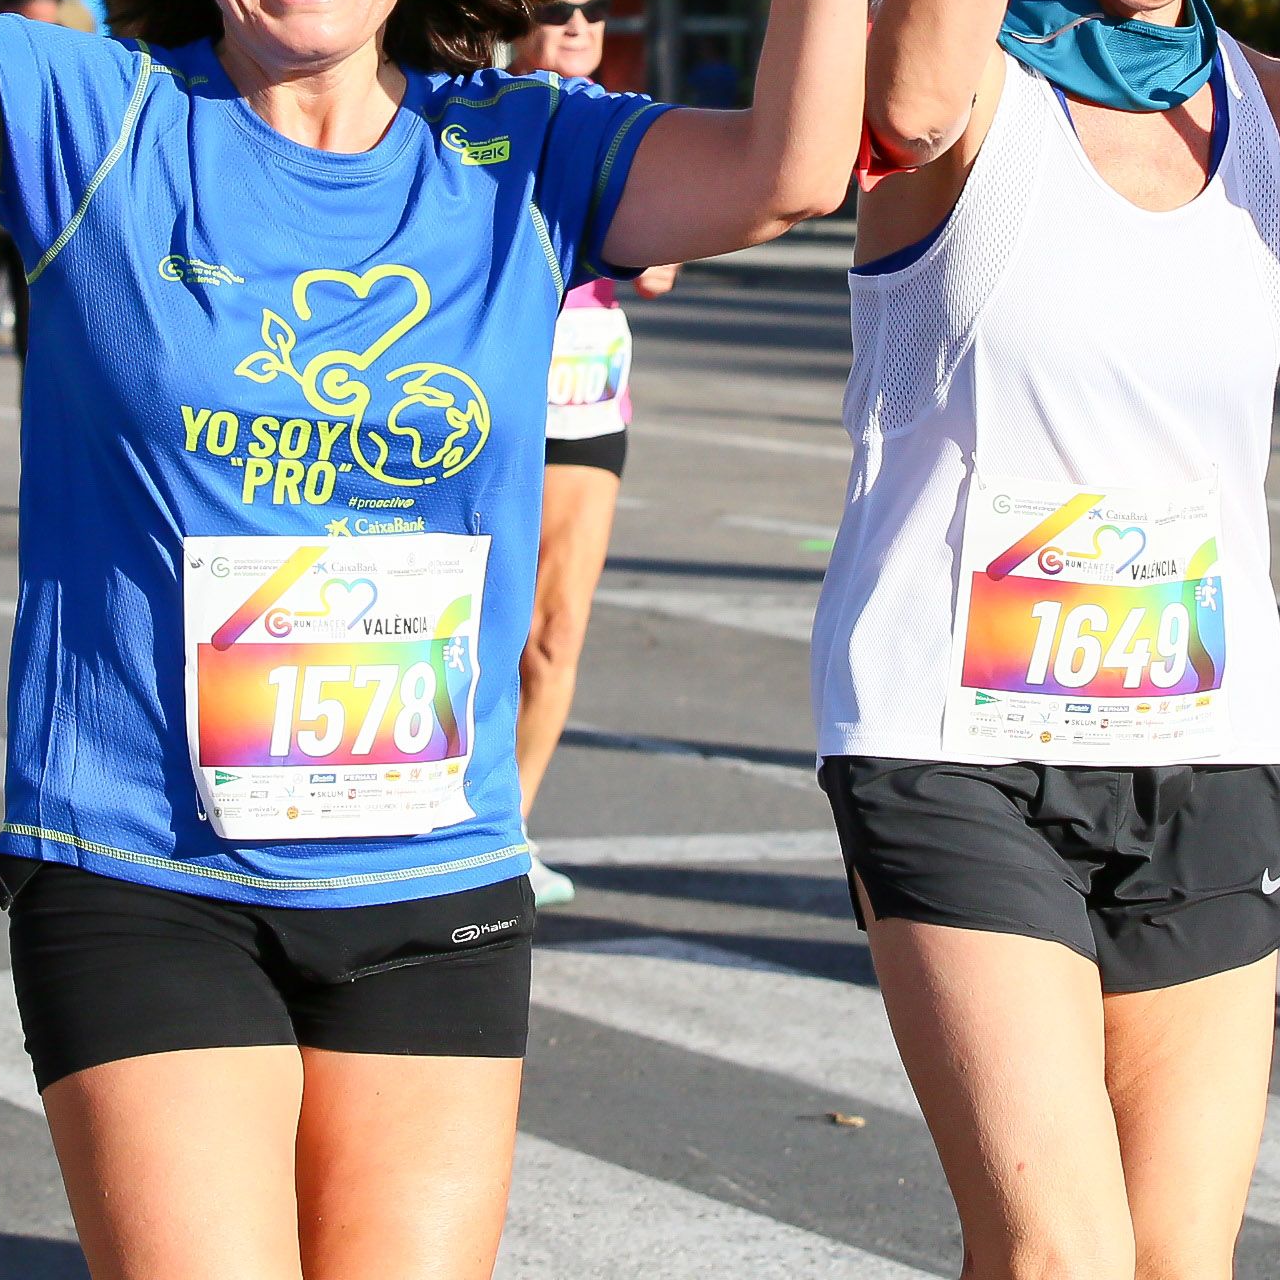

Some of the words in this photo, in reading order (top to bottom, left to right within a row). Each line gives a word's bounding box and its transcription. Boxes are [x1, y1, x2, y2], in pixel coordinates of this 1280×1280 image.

[180, 405, 240, 456] YO
[248, 415, 348, 460] SOY
[354, 516, 425, 534] CaixaBank
[331, 561, 377, 572] CaixaBank
[363, 614, 428, 635] VALÈNCIA
[1025, 599, 1190, 690] 1649
[267, 661, 436, 758] 1578
